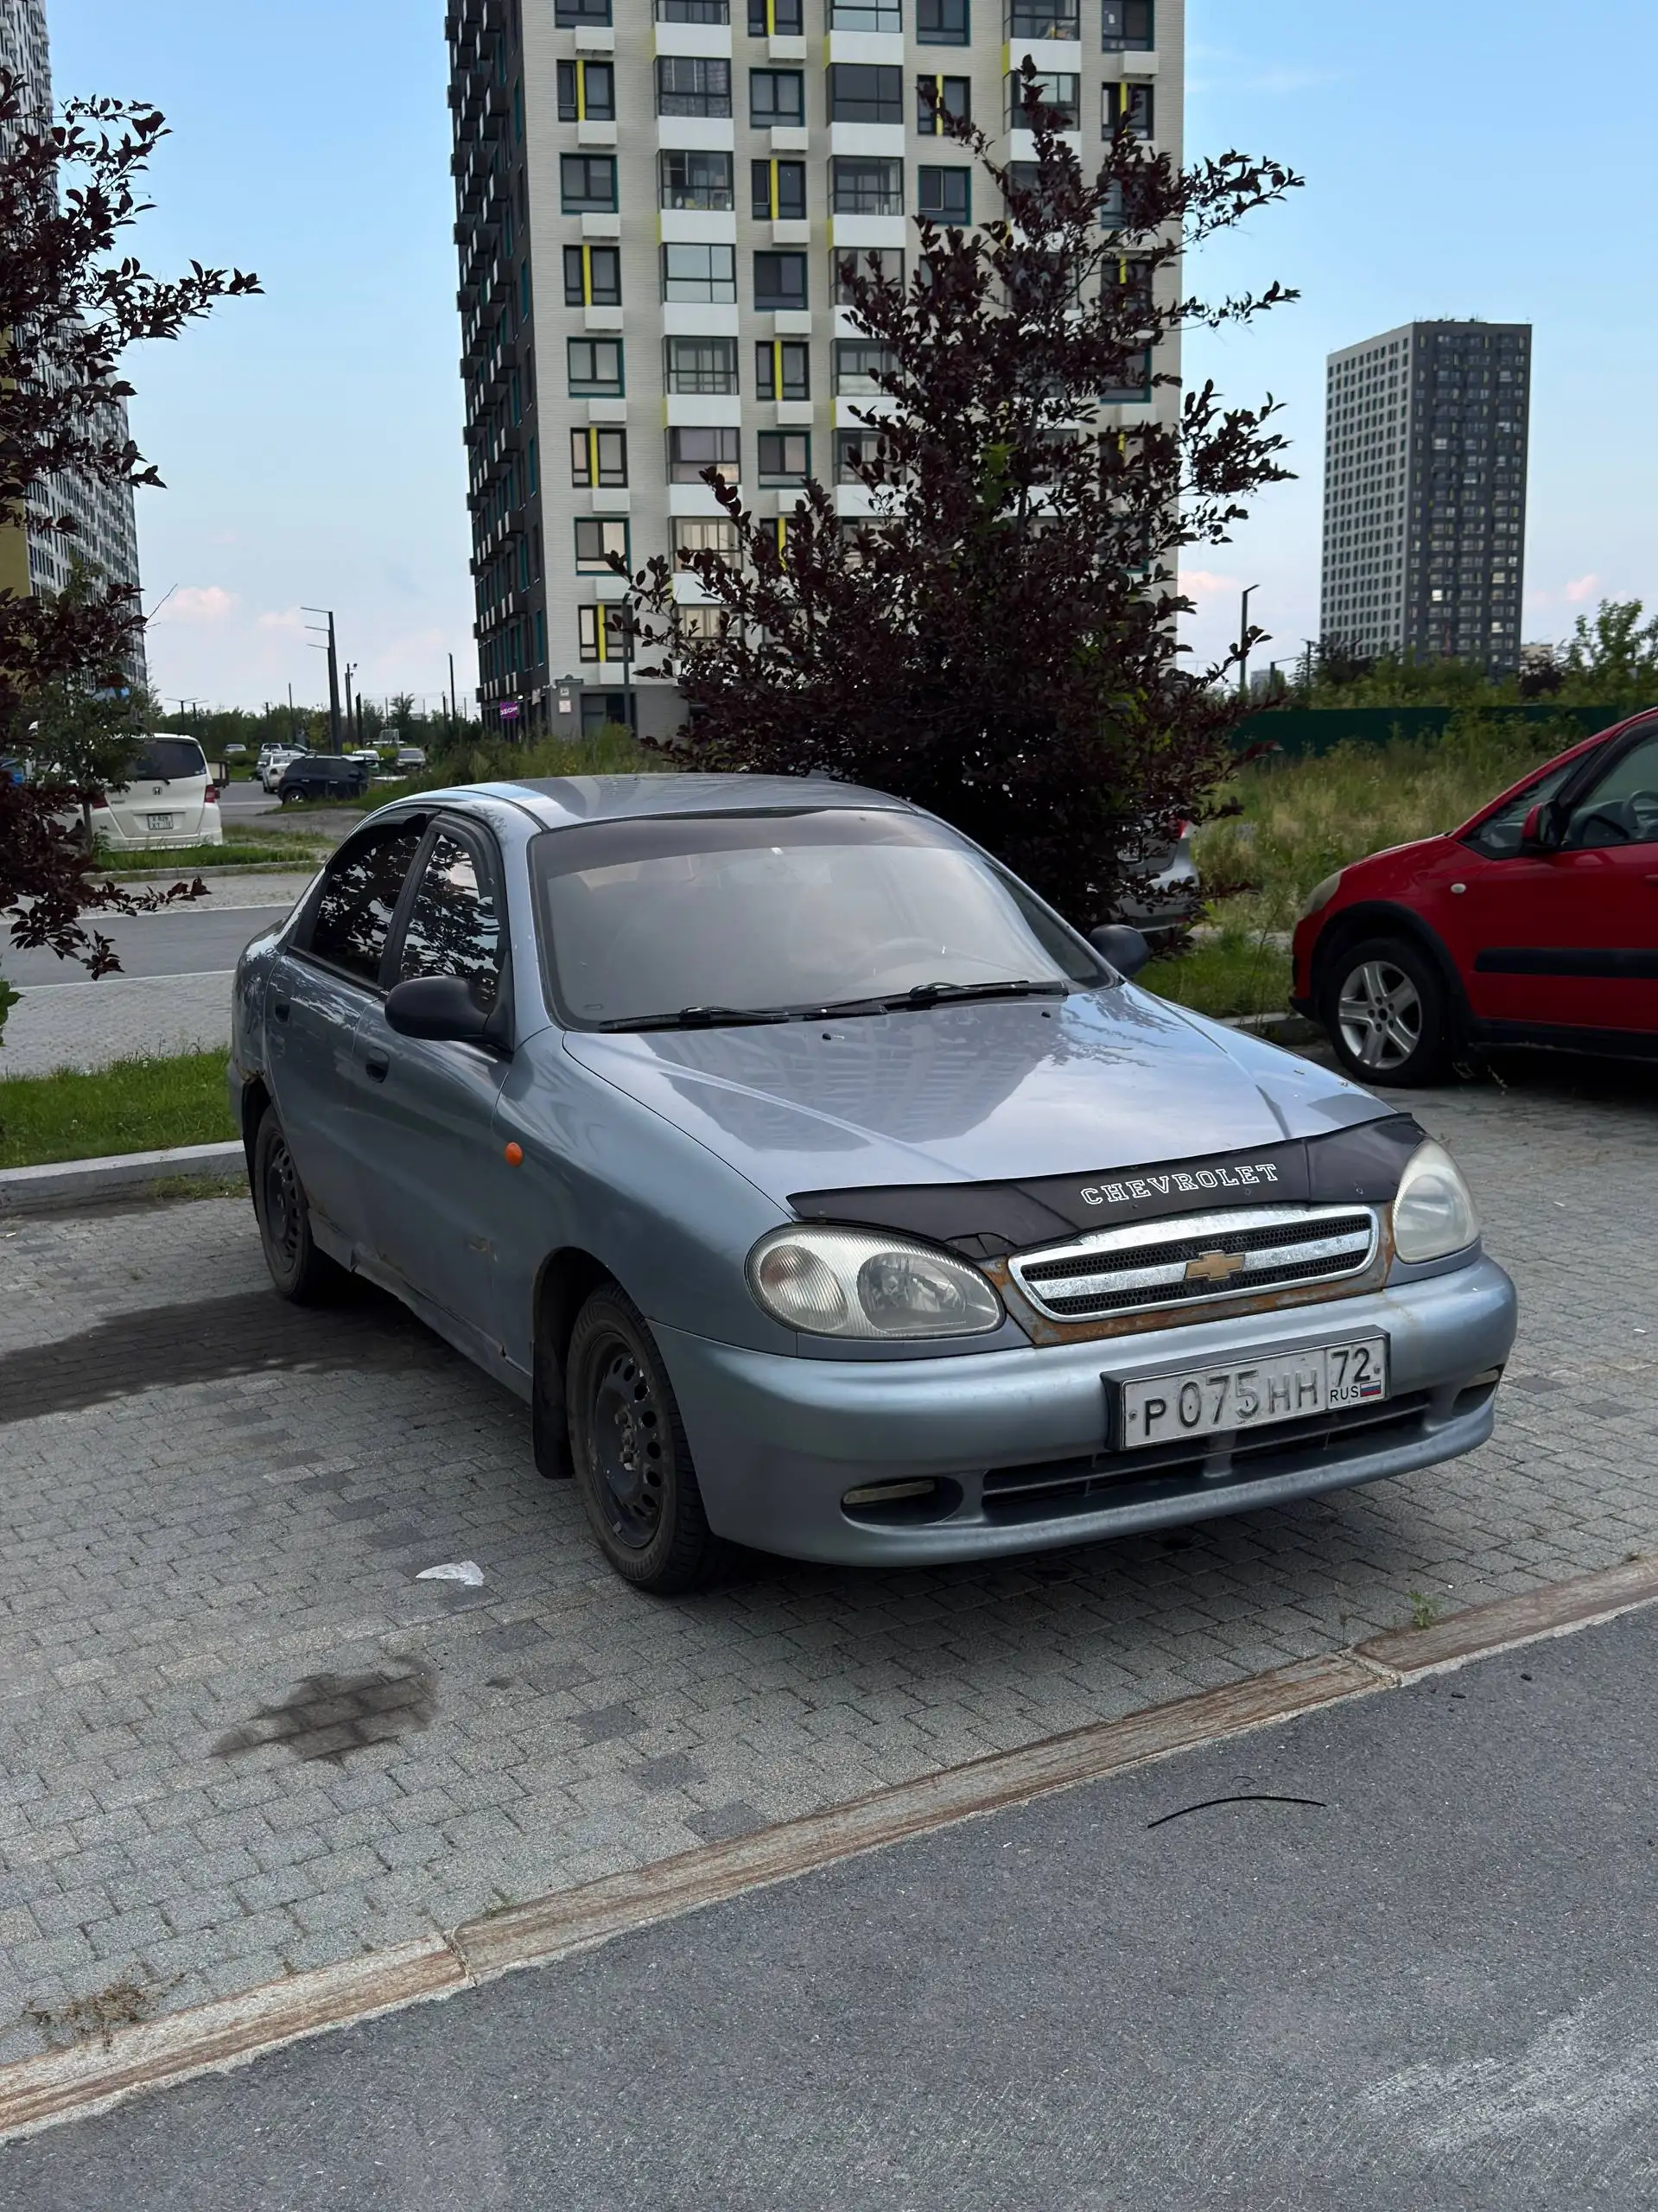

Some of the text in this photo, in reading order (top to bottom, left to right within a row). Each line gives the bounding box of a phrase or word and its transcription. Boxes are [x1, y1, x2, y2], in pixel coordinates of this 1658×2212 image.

[1080, 1163, 1279, 1205] CHEVROLET
[1331, 1347, 1371, 1388] 72
[1329, 1384, 1360, 1402] RUS
